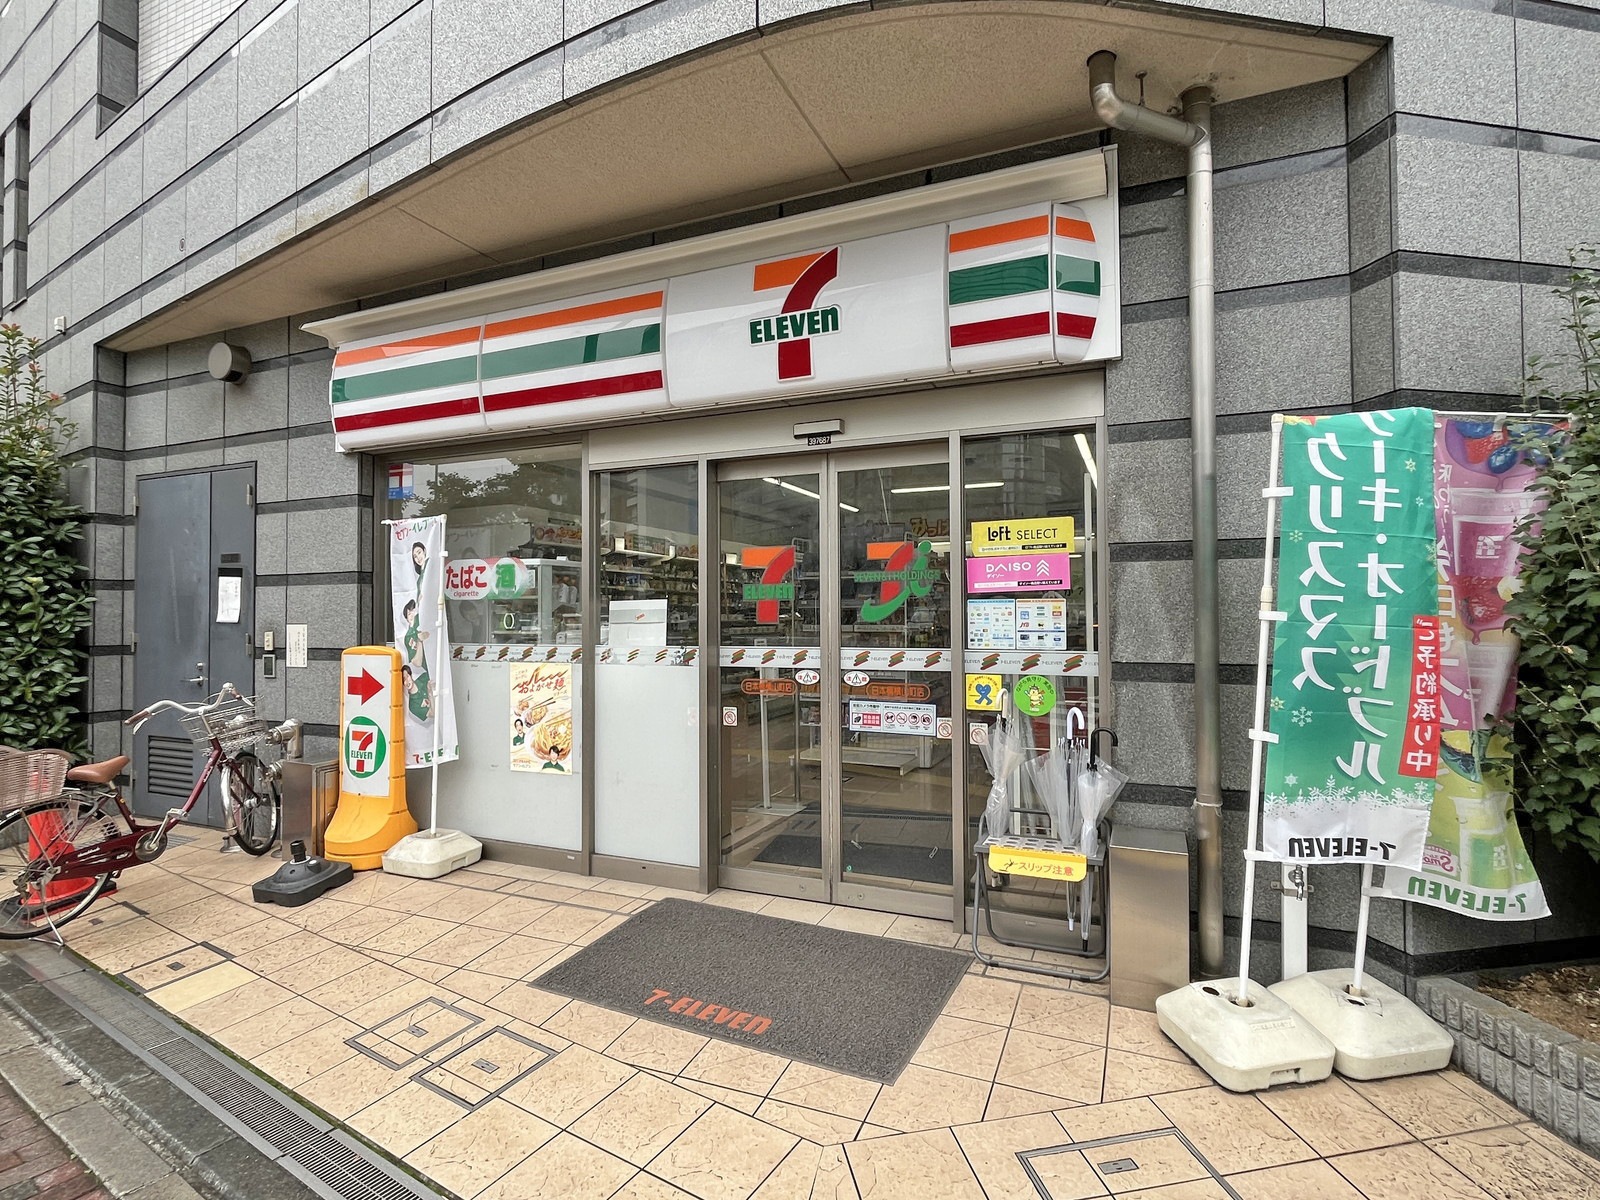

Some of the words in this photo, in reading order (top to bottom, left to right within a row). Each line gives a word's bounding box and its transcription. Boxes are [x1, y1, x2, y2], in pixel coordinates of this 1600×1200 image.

[988, 526, 1011, 541] Loft
[1016, 528, 1058, 540] SELECT
[986, 562, 1032, 573] DAISO
[446, 565, 487, 589] たばこ
[453, 590, 480, 598] cigarette
[1018, 861, 1074, 877] スリップ注意
